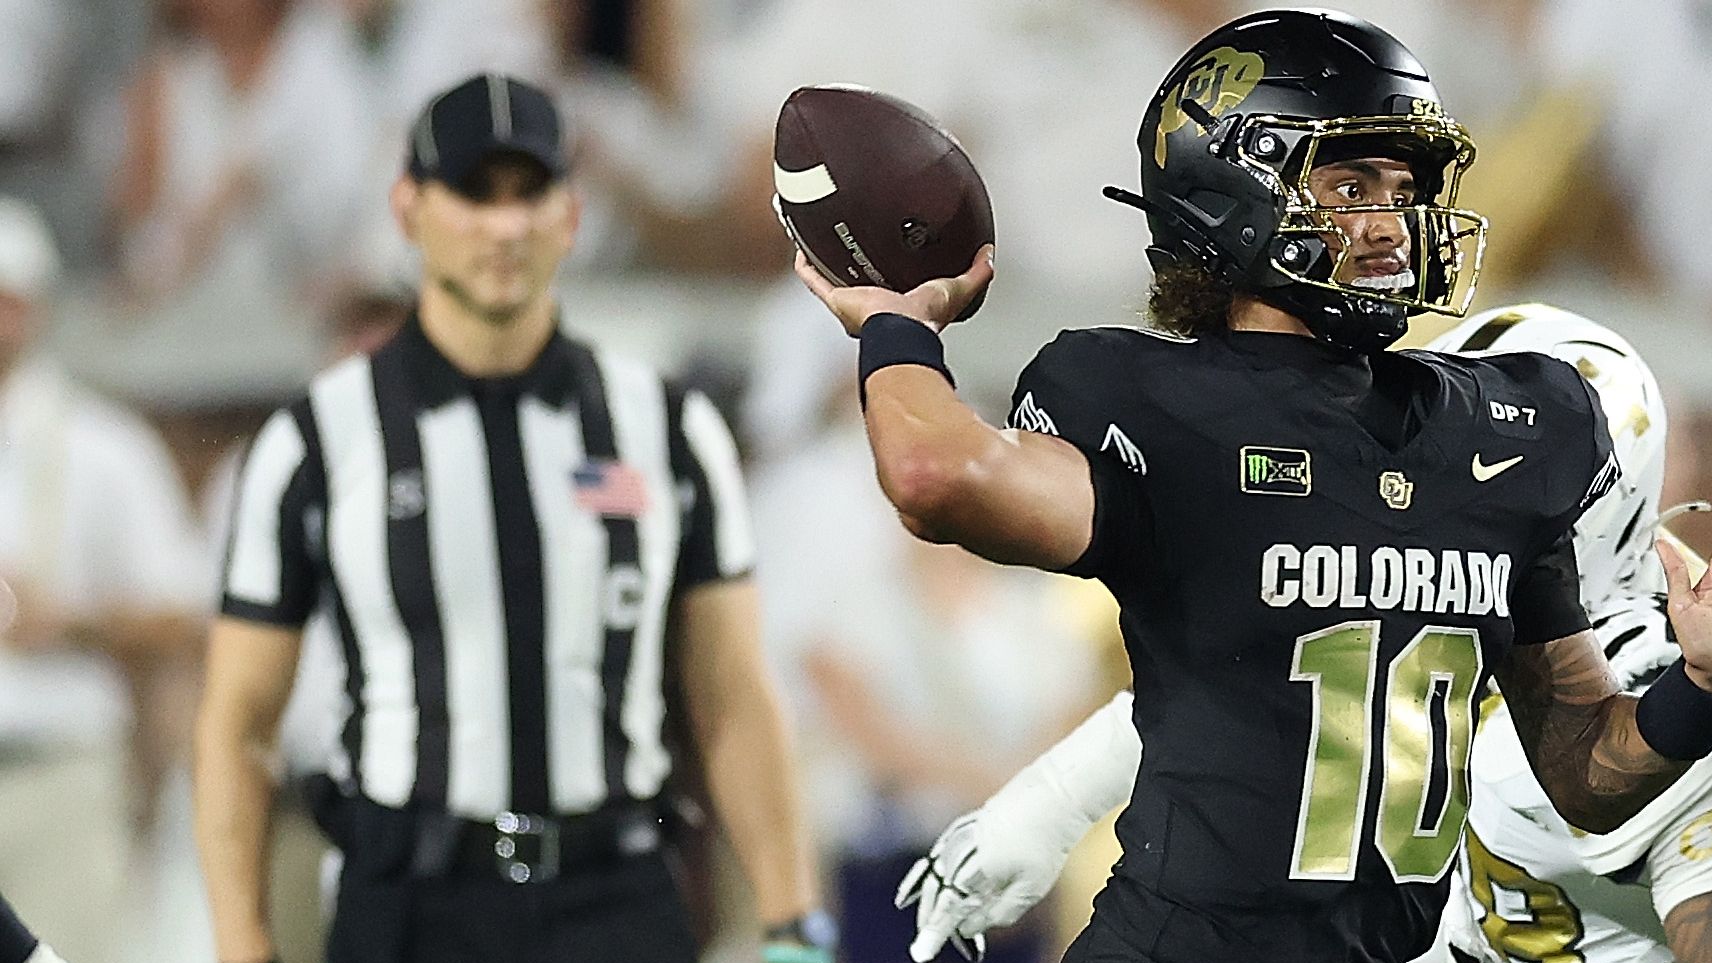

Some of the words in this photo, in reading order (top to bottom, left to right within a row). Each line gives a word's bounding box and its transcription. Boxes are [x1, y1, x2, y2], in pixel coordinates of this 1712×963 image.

[1490, 401, 1520, 421] DP
[1521, 407, 1536, 426] 7
[1261, 543, 1512, 617] COLORADO
[1289, 620, 1483, 884] 10
